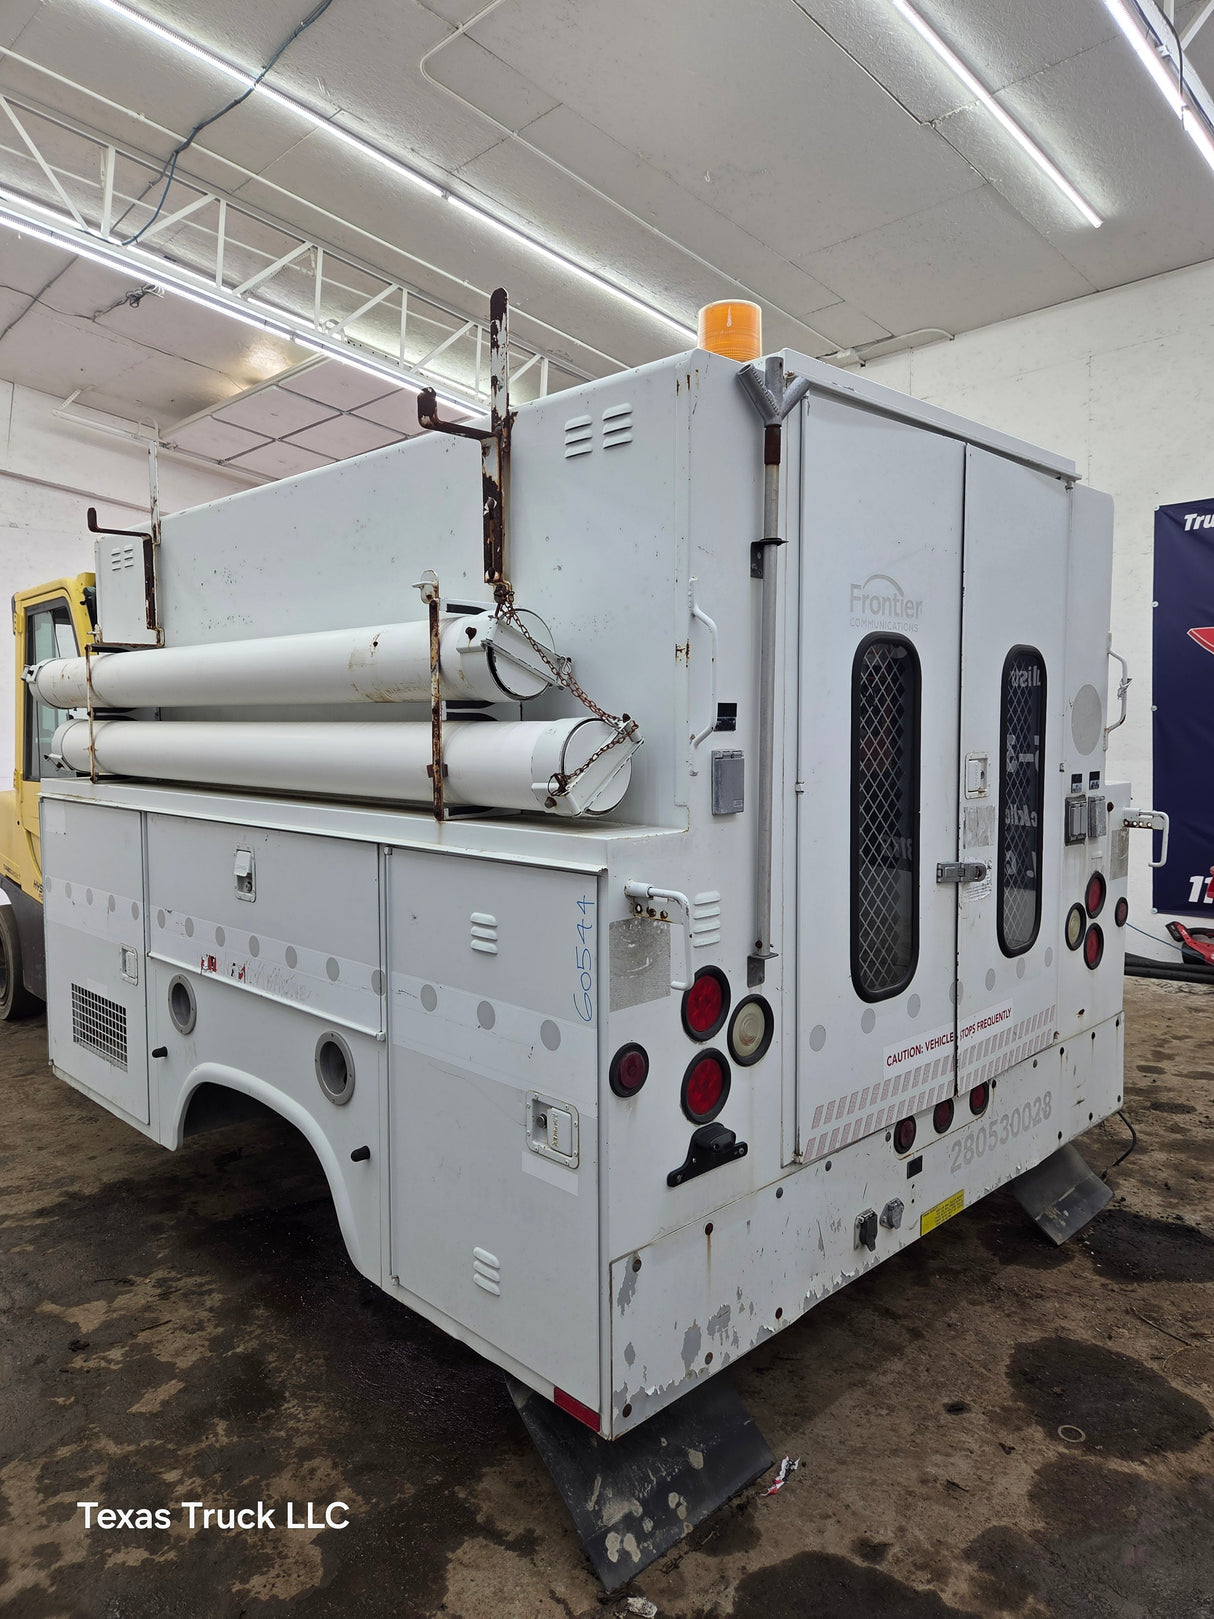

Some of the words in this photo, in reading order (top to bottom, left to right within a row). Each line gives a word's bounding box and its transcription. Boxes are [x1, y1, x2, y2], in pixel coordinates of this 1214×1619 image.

[850, 583, 924, 619] Frontier
[850, 617, 919, 632] COMMUNICATIONS
[573, 895, 595, 1022] 60544
[886, 1044, 924, 1067] CAUTION:
[924, 1031, 954, 1052] VEHICLE
[976, 1007, 1012, 1032] FREQUENTLY
[950, 1090, 1052, 1174] 280530028
